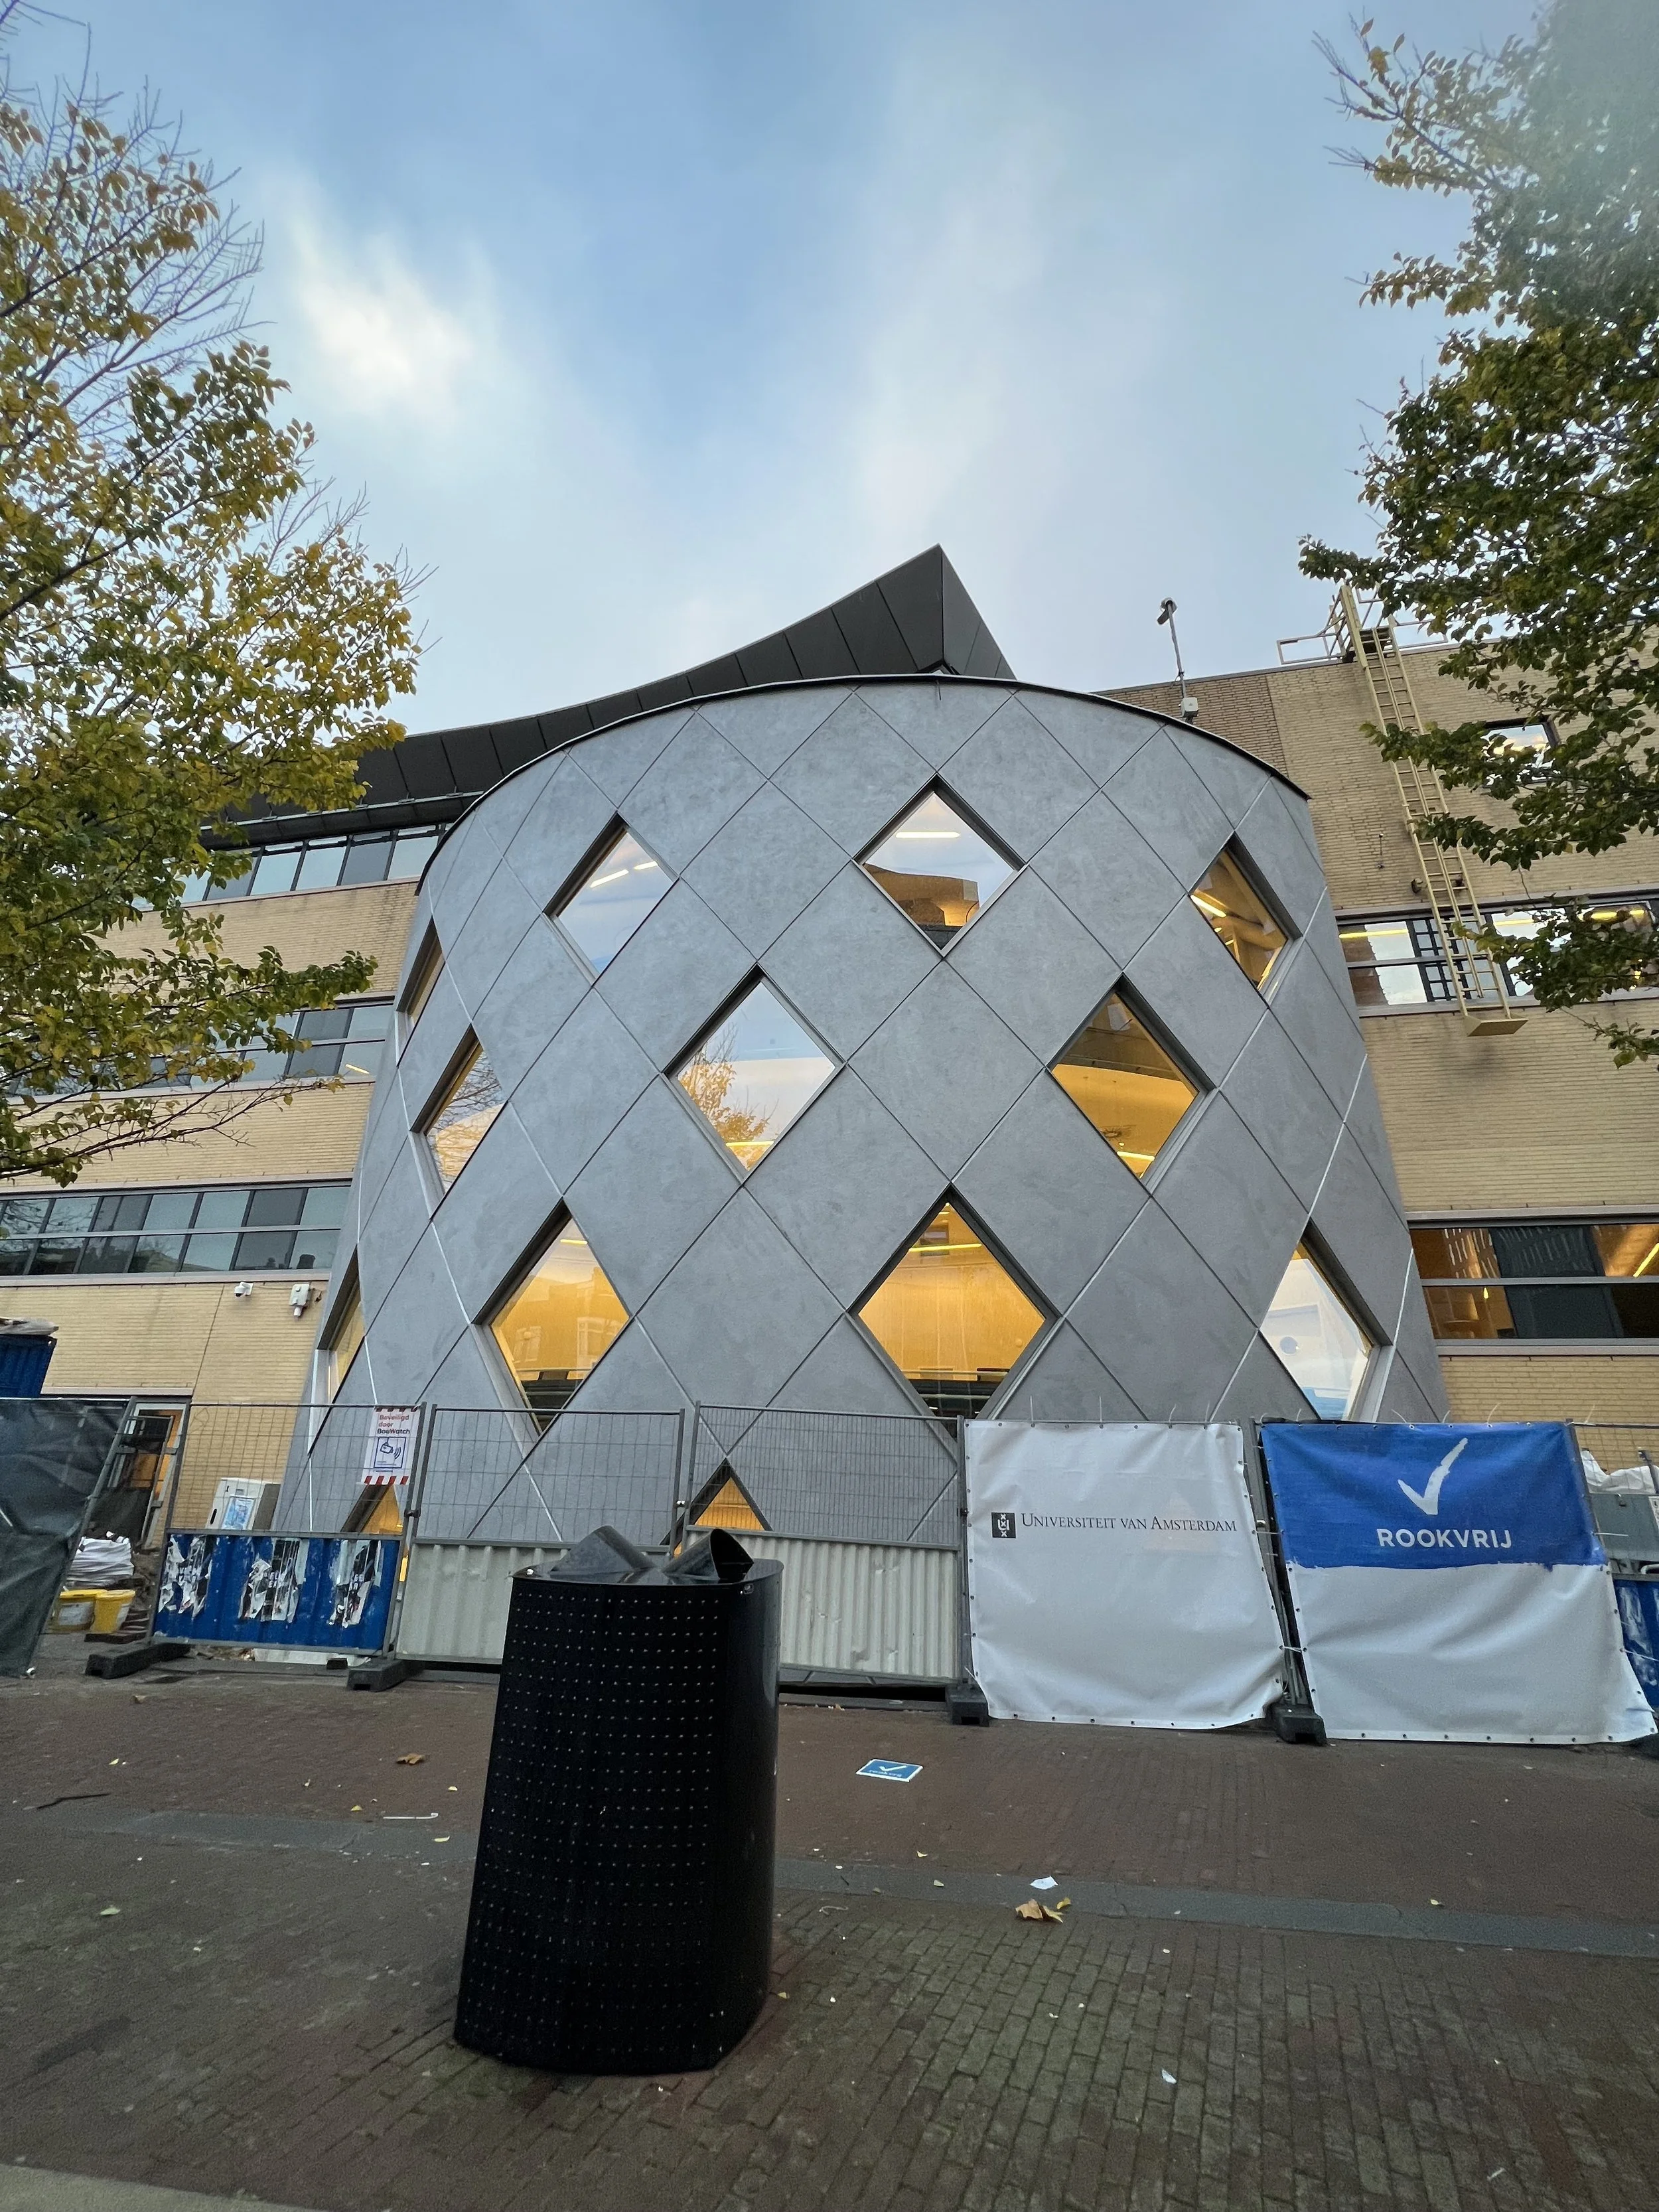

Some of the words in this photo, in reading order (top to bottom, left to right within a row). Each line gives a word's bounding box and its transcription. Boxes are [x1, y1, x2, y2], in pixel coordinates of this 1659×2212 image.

[1021, 1512, 1116, 1529] UNIVERSITEIT
[1120, 1518, 1147, 1530] VAN
[1151, 1515, 1238, 1532] AMSTERDAM
[1376, 1528, 1512, 1548] ROOKVRIJ
